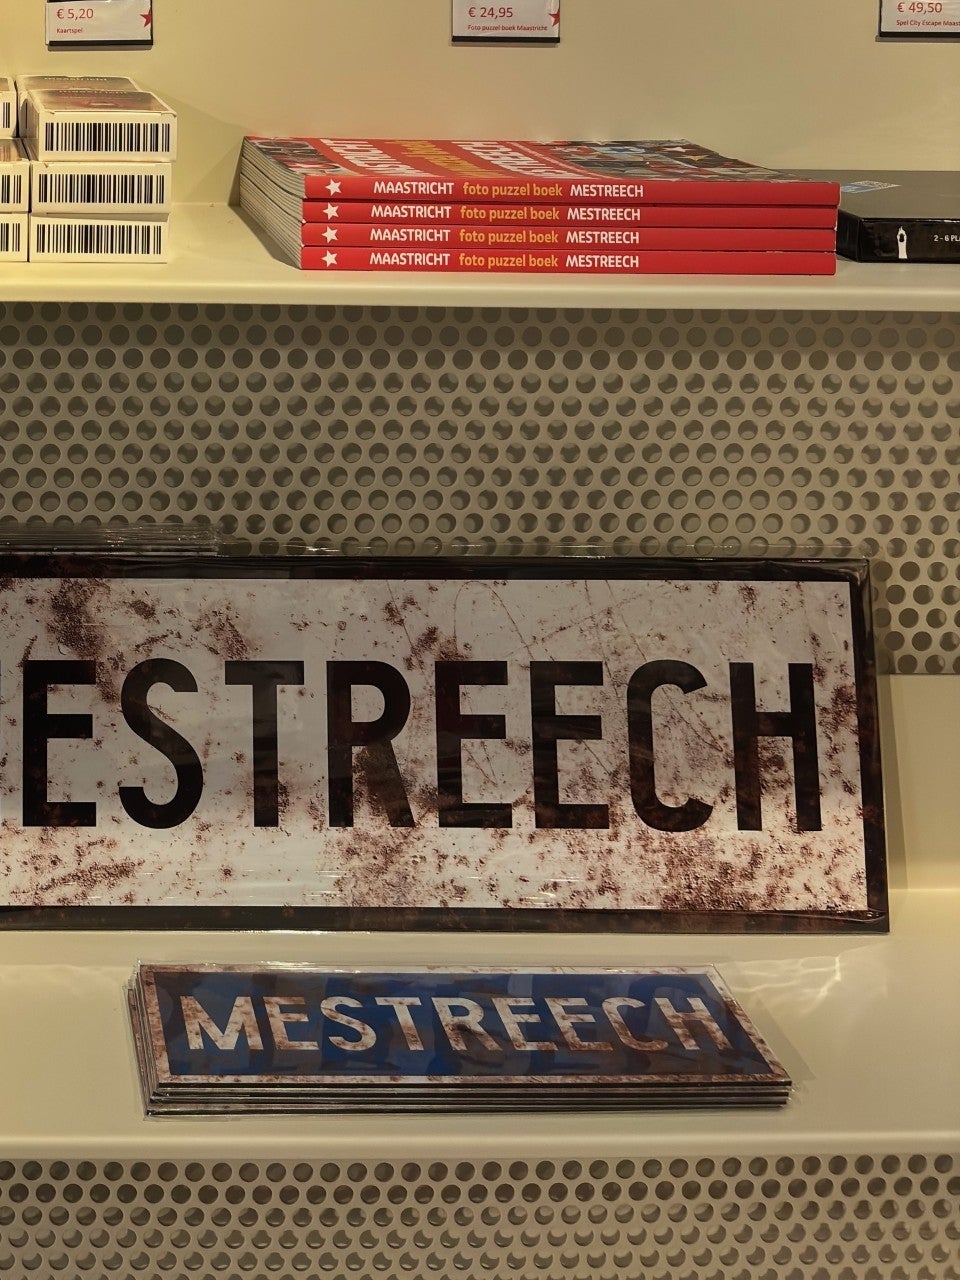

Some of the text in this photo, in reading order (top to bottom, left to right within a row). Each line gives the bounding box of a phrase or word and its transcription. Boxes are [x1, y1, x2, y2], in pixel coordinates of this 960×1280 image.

[56, 8, 94, 21] € 5,20
[468, 6, 514, 20] € 24,95
[897, 1, 943, 14] € 49,50
[896, 19, 909, 27] Spel
[56, 27, 83, 35] Kaartspel
[373, 180, 645, 198] MAASTRICHT foto puzzel boek MESTREECH
[370, 205, 641, 222] MAASTRICHT foto puzzel boek MESTREECH
[369, 228, 640, 246] MAASTRICHT foto puzzel boek MESTREECH
[933, 234, 939, 242] 2
[369, 252, 640, 270] MAASTRICHT foto puzzel boek MESTREECH
[176, 993, 735, 1054] MESTREECH
